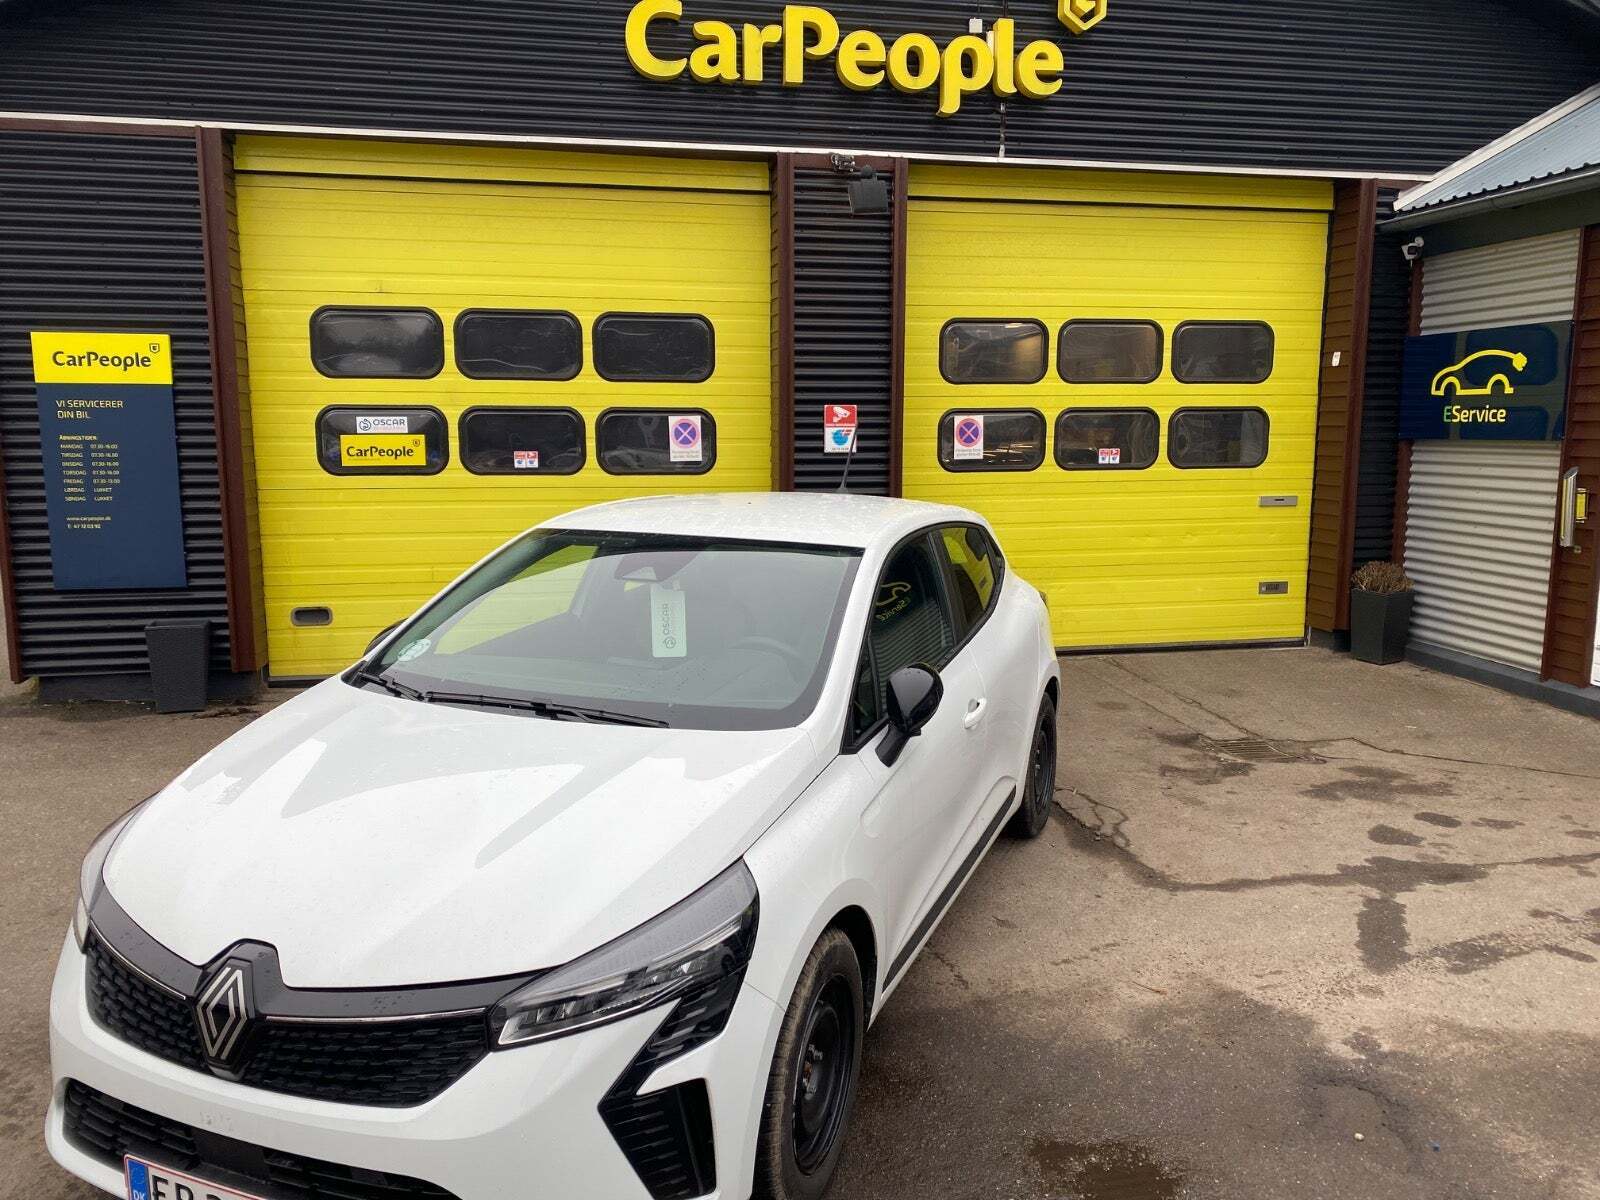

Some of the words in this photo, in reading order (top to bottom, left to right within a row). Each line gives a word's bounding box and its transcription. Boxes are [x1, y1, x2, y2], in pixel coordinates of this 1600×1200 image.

[624, 0, 1064, 117] CarPeople
[52, 351, 152, 371] CarPeople
[55, 400, 66, 409] VI
[67, 400, 124, 409] SERVICERER
[57, 410, 75, 419] DIN
[76, 410, 91, 419] BIL
[1443, 404, 1507, 423] EService
[373, 418, 406, 426] OSCAR
[346, 445, 414, 460] CarPeople
